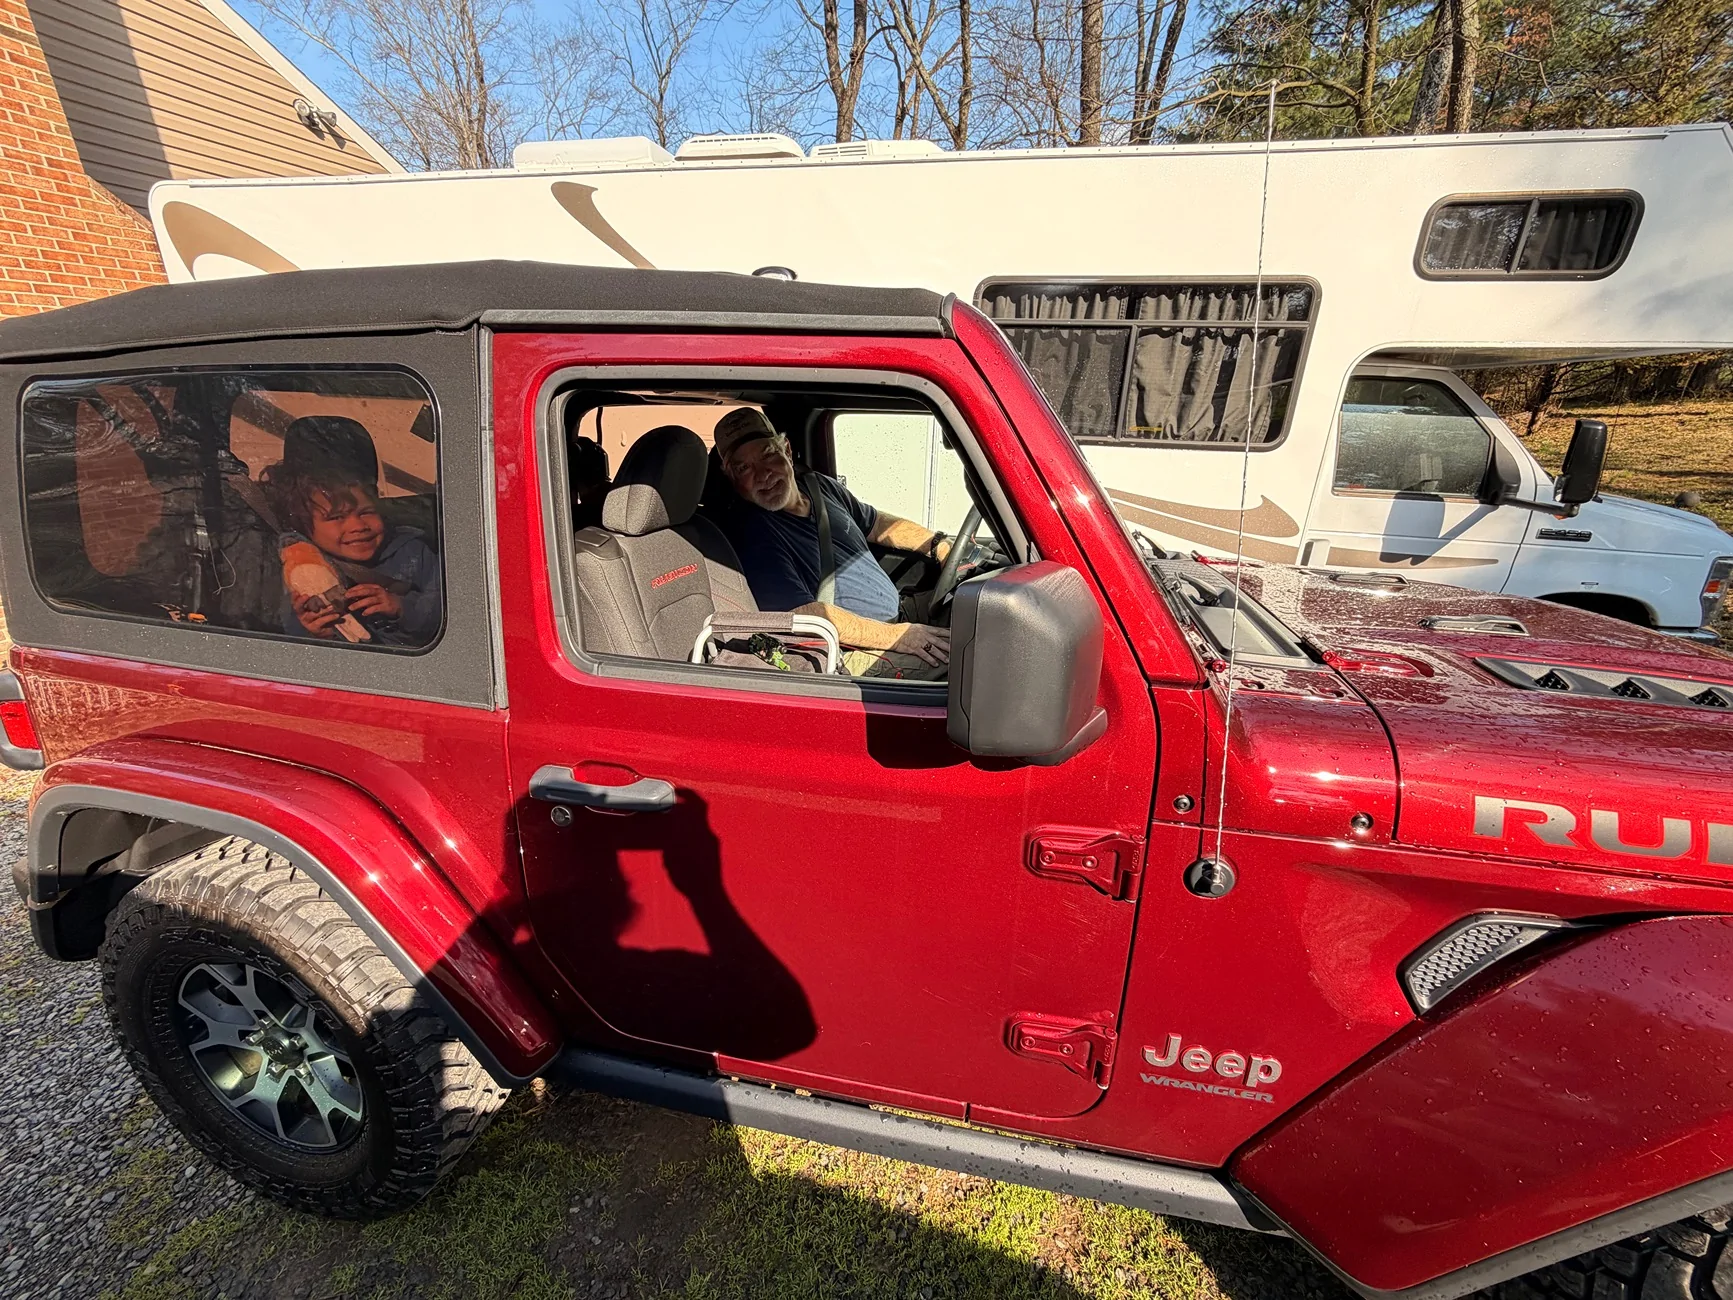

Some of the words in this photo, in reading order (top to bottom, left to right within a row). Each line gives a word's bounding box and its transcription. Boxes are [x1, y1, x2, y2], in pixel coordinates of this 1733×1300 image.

[1472, 795, 1733, 865] RU
[1139, 1072, 1274, 1103] WRANGLER
[1142, 1032, 1283, 1088] Jeep
